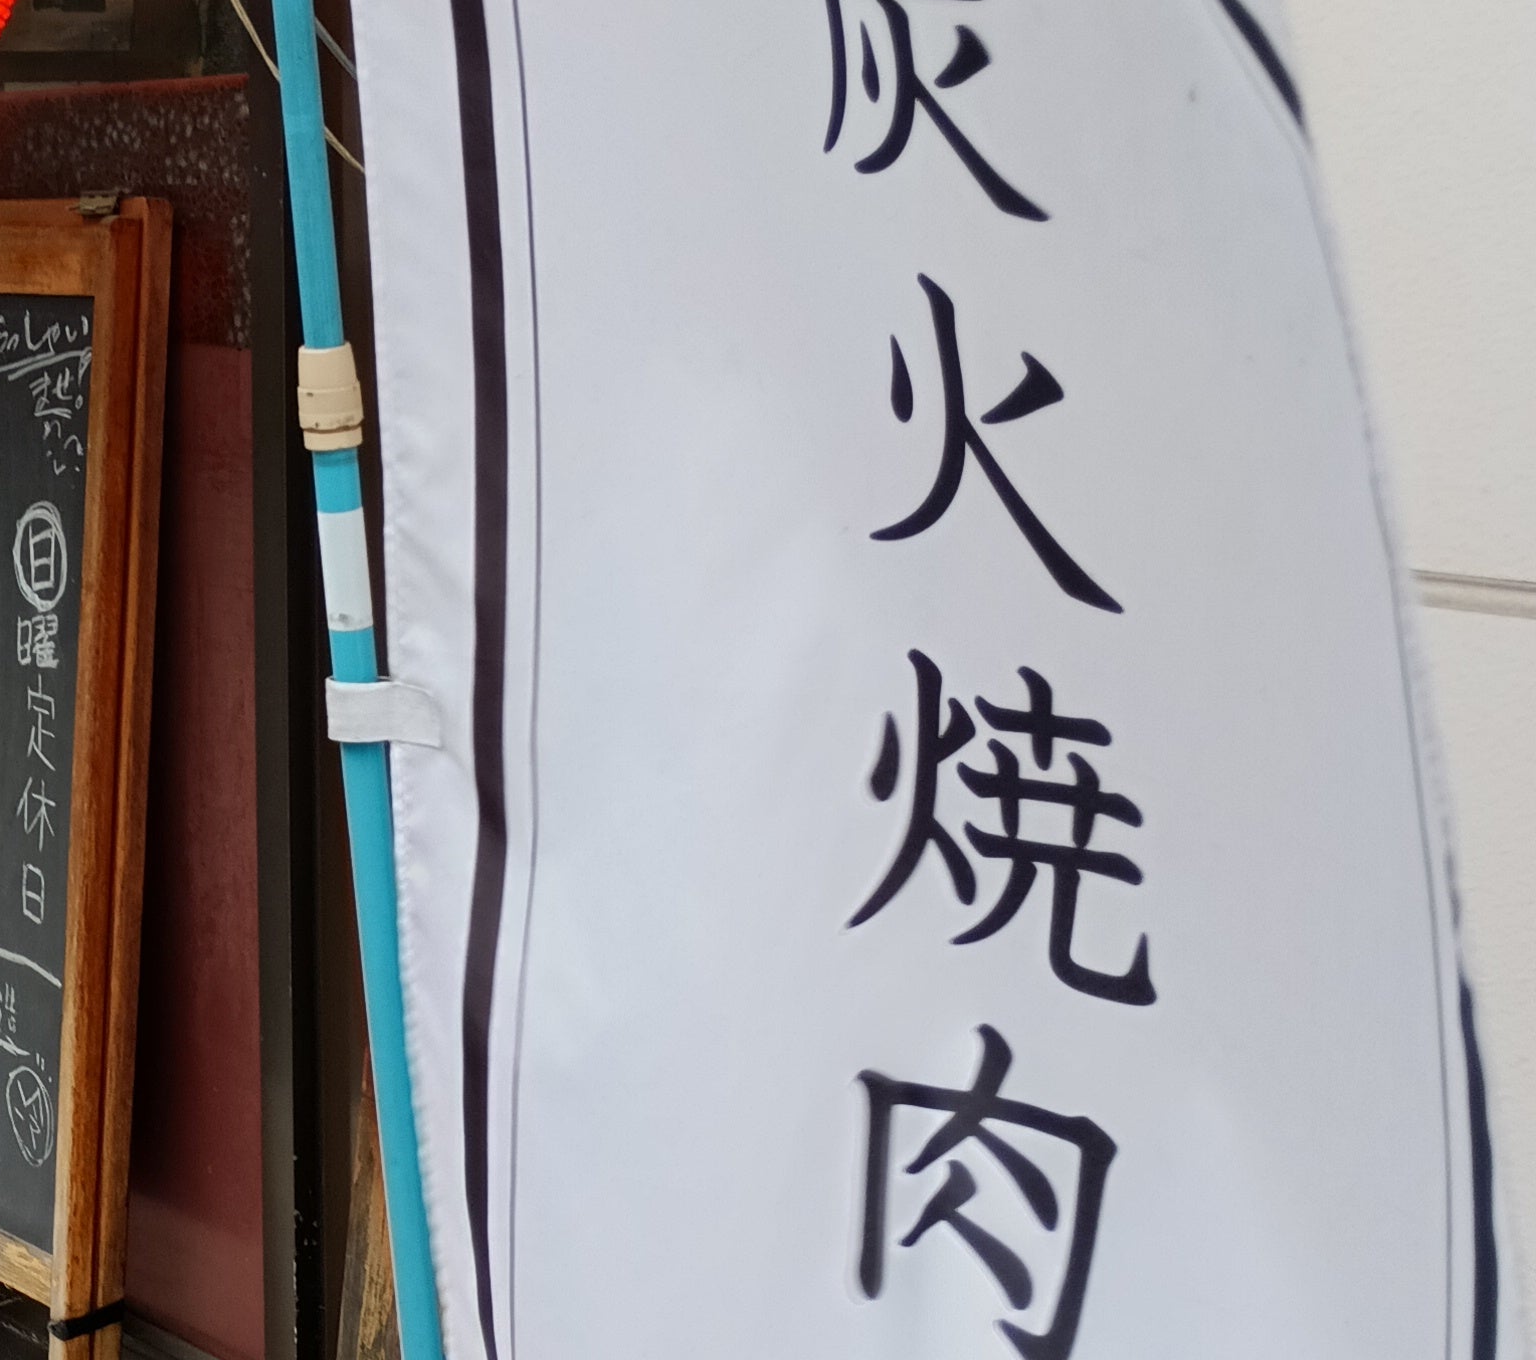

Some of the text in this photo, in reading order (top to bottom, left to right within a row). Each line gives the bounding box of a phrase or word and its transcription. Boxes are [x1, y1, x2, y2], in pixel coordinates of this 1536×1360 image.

[15, 505, 67, 925] 日曜定休日
